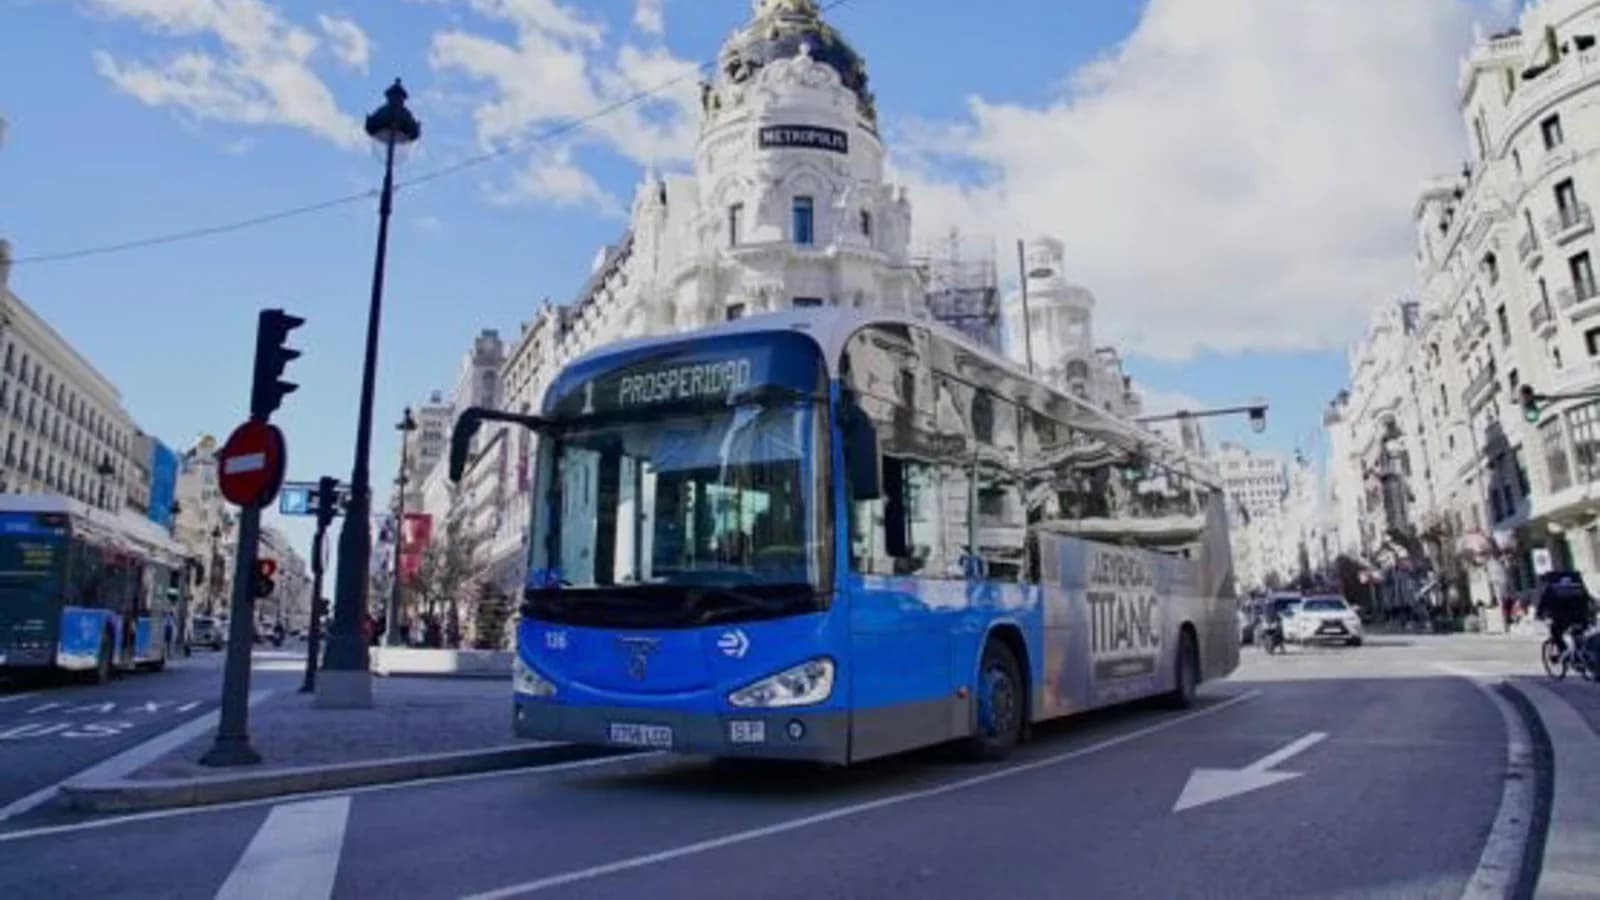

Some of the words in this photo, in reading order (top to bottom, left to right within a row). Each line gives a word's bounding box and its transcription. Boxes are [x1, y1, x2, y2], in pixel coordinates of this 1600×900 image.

[763, 129, 844, 148] METROPOLIS
[580, 382, 595, 414] 1
[618, 359, 751, 405] PROSPERIDAD
